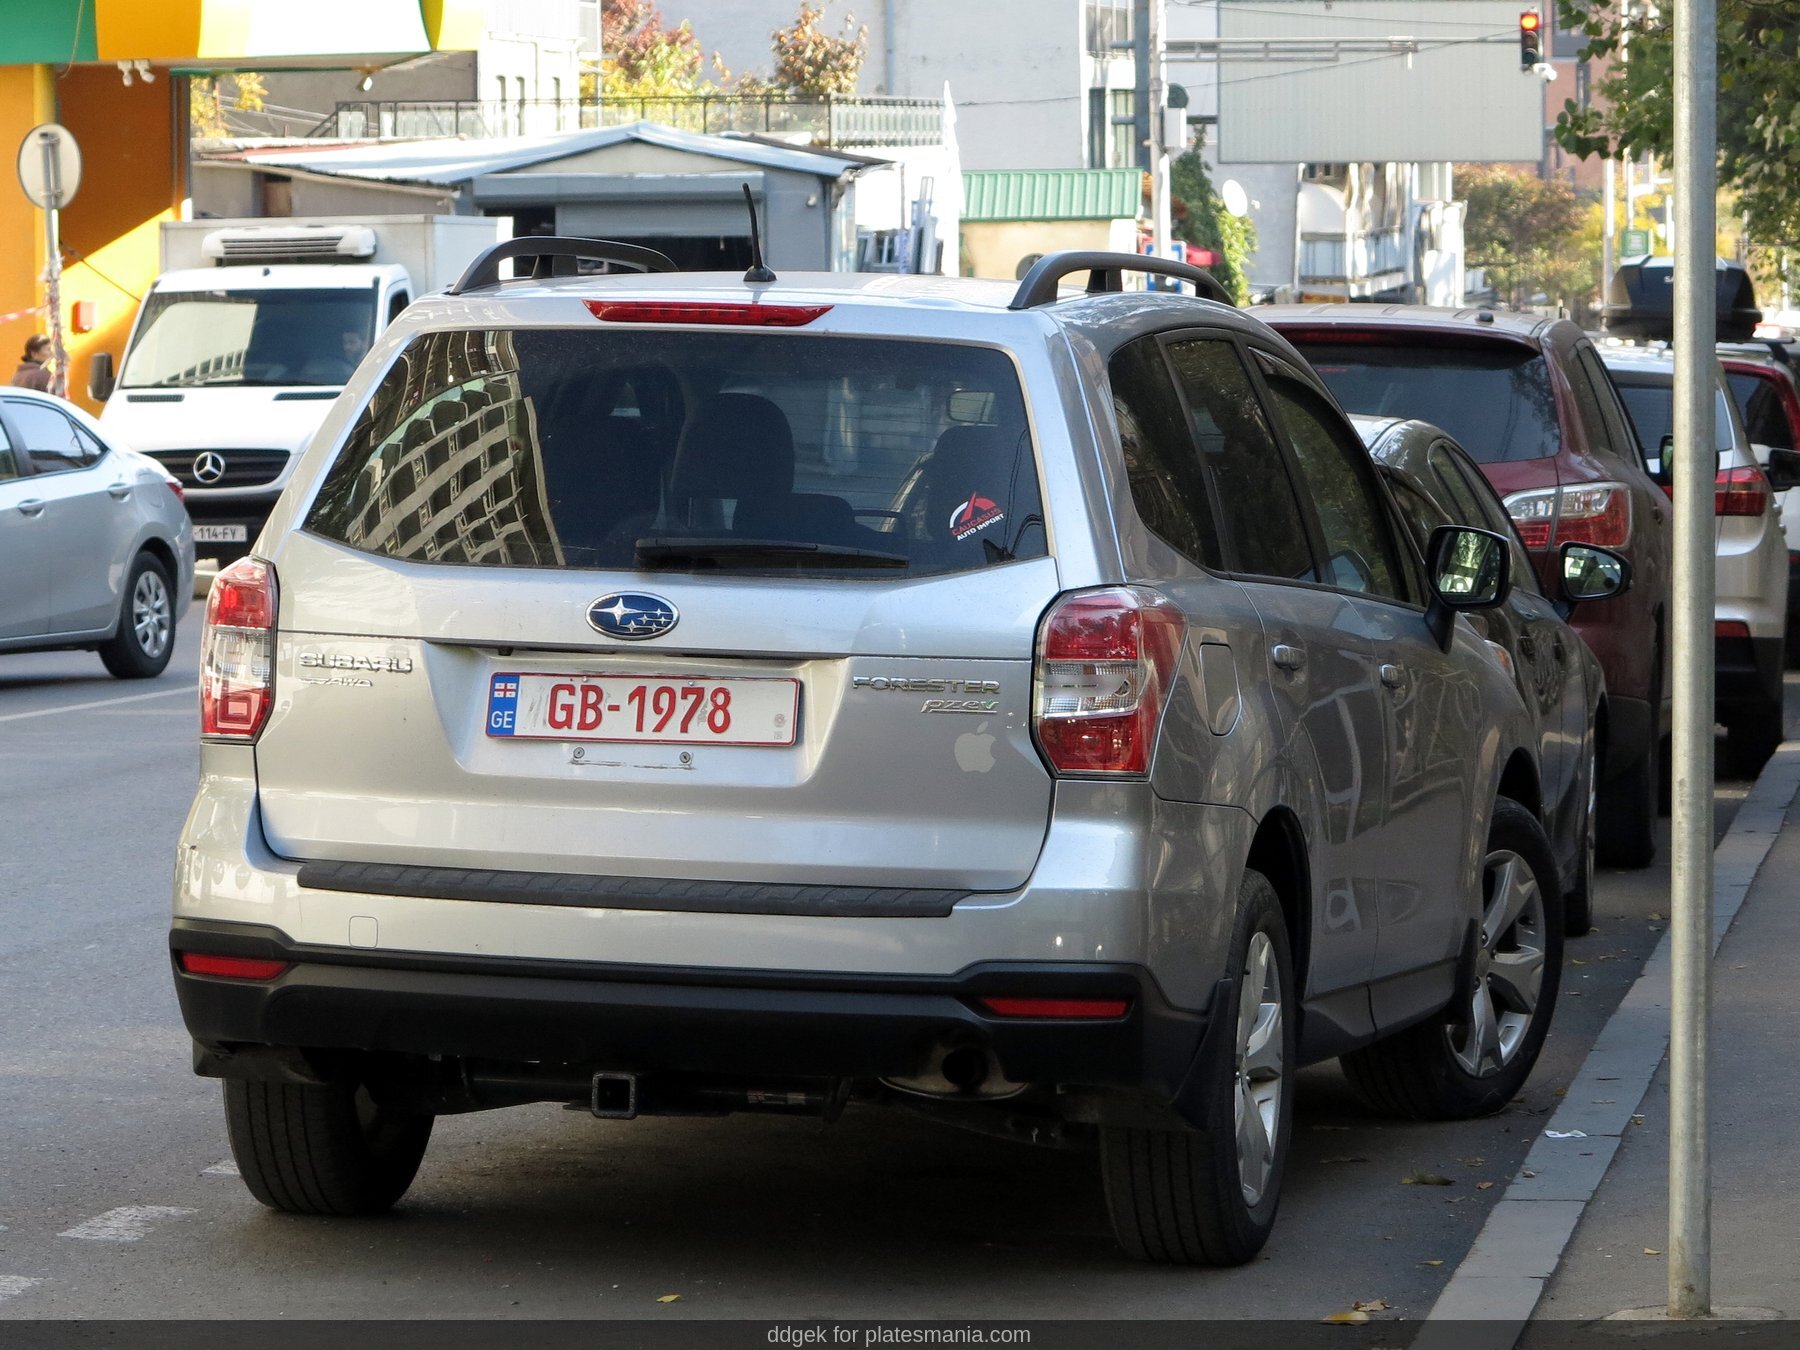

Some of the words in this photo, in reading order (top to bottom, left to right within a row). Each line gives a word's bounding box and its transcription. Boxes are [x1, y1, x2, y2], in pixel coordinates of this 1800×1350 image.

[956, 527, 977, 541] AUTO
[977, 513, 1005, 531] IMPORT
[299, 652, 413, 673] SUBARU
[852, 676, 1001, 695] FORESTER
[547, 682, 732, 735] GB-1978
[491, 710, 513, 730] GE
